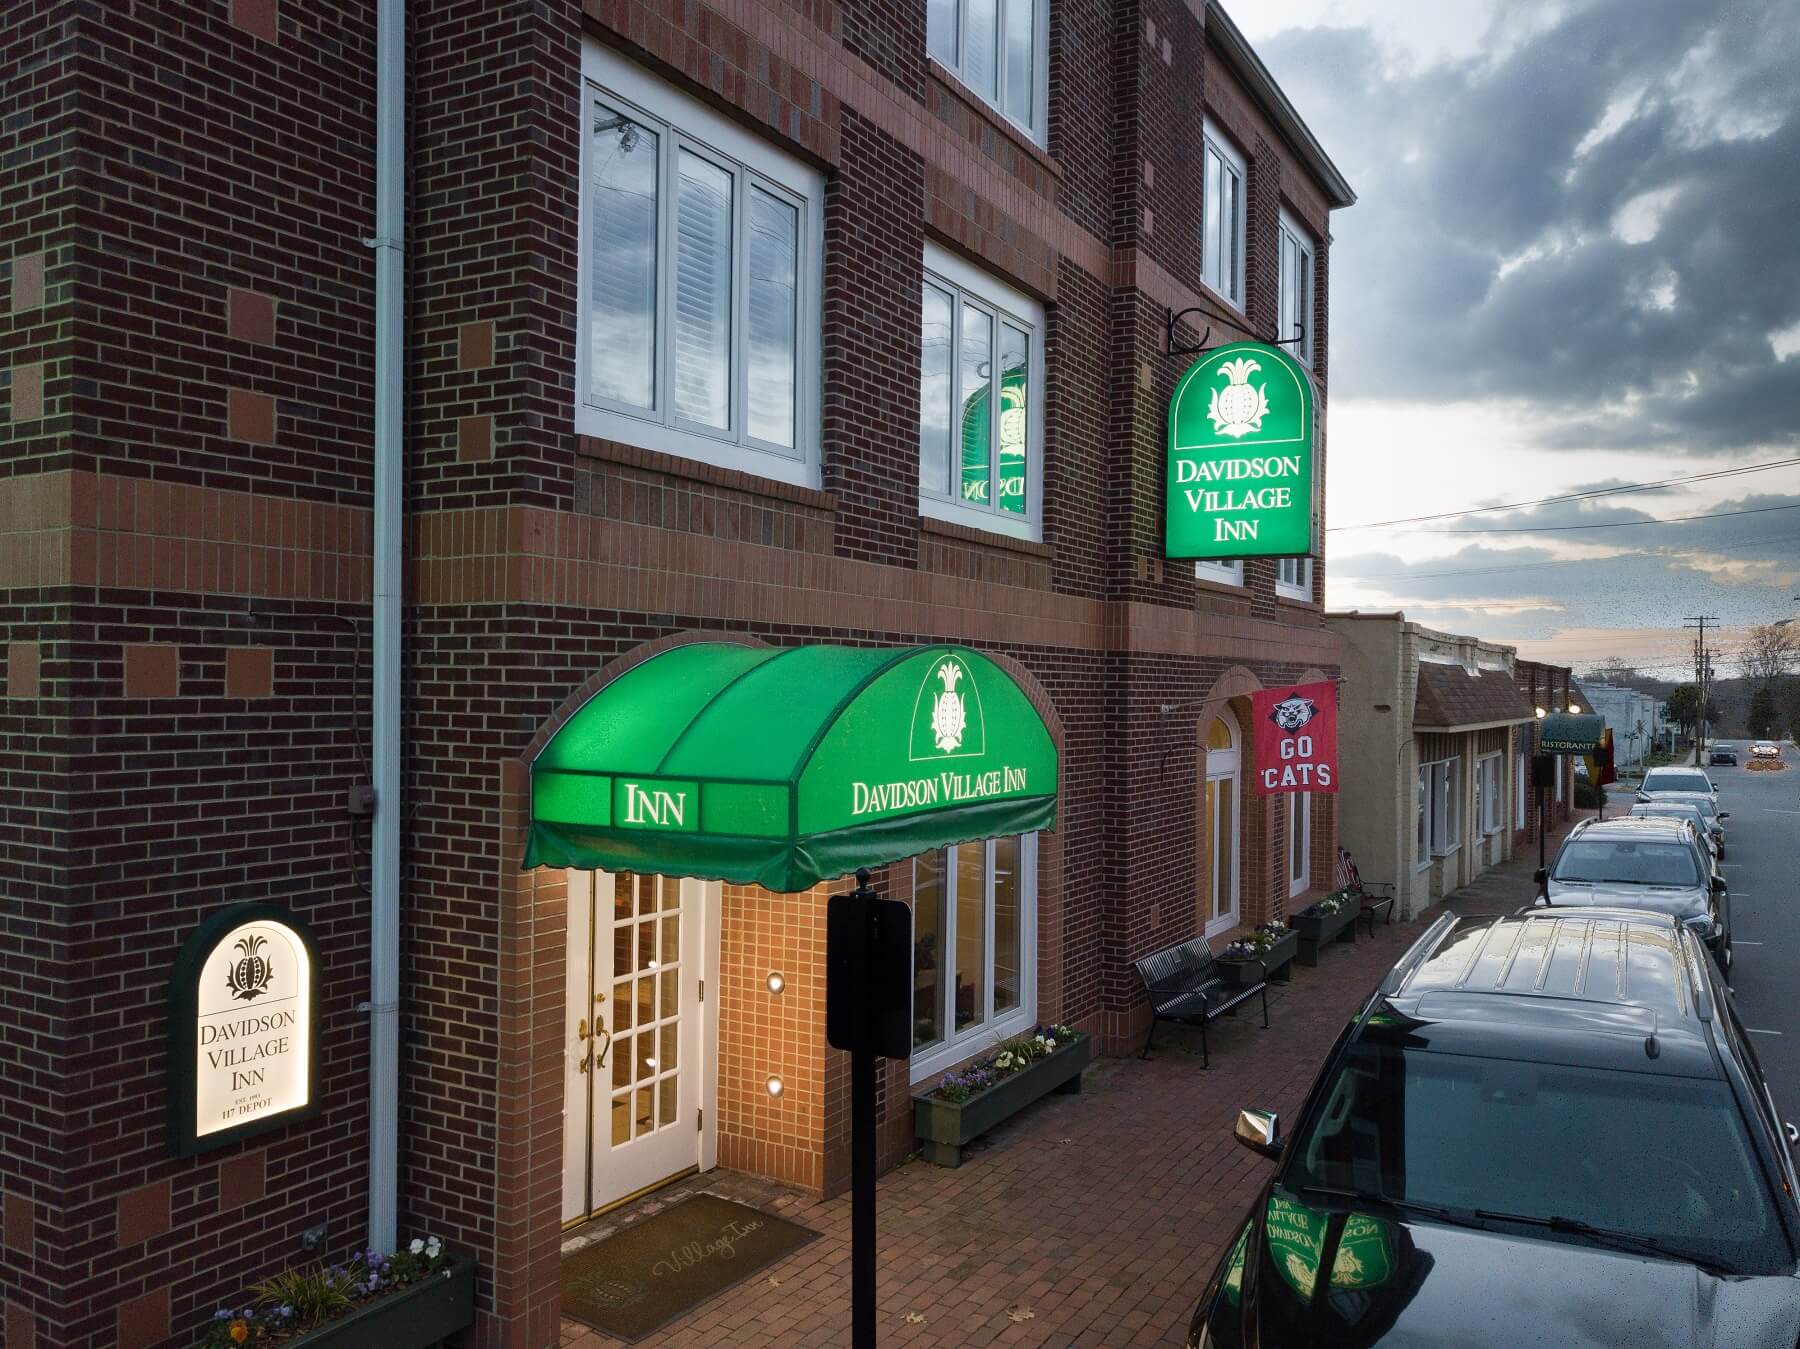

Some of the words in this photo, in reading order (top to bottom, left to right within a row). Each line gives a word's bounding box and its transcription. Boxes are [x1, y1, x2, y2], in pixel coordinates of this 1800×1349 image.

[1175, 456, 1301, 483] DAVIDSON
[1184, 487, 1292, 512] VILLAGE
[1213, 517, 1259, 543] INN
[1280, 735, 1313, 760] GO
[1260, 764, 1331, 789] 'CATS
[851, 779, 938, 815] DAVIDSON
[941, 771, 1001, 801] VILLAGE
[1003, 767, 1026, 793] INN
[624, 783, 687, 826] INN
[200, 1009, 296, 1046] DAVIDSON
[207, 1036, 289, 1069] VILLAGE
[231, 1067, 265, 1092] INN
[222, 1108, 236, 1120] 117
[239, 1097, 273, 1115] DEPOT
[652, 1235, 736, 1276] Village
[721, 1219, 765, 1242] Inn
